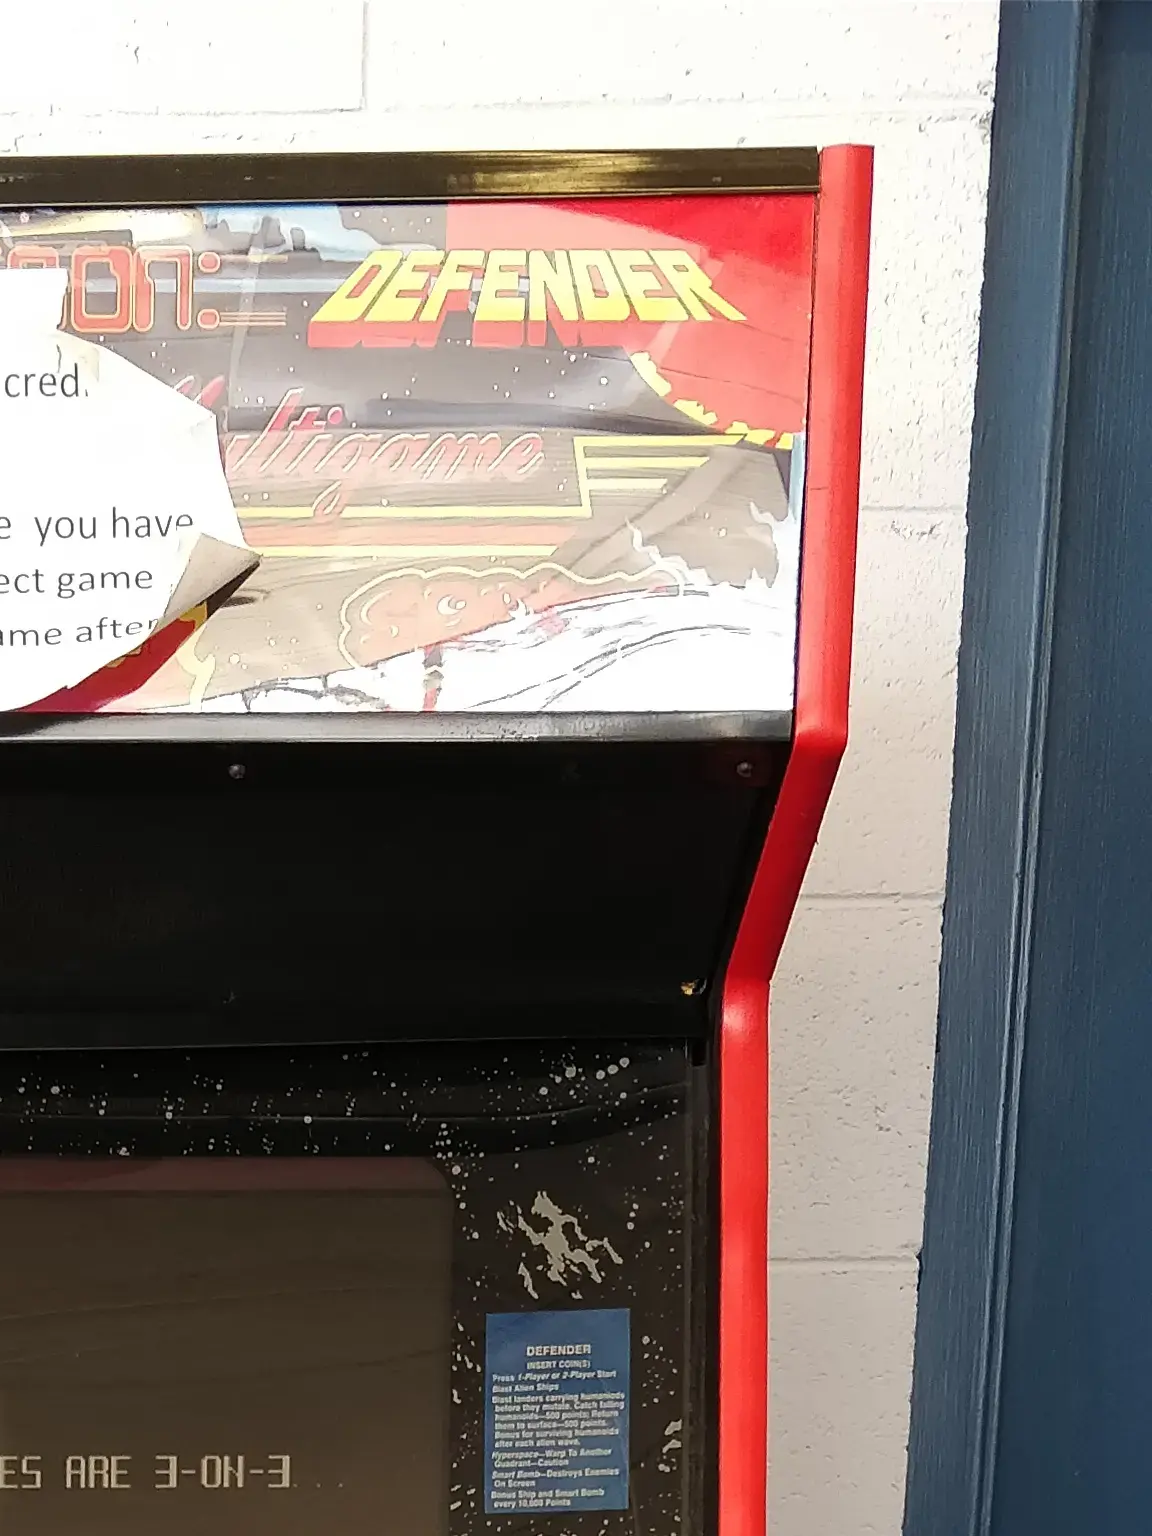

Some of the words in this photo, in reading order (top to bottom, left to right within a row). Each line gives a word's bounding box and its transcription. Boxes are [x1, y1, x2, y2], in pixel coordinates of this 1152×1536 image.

[309, 249, 746, 347] DEFENDER
[175, 376, 545, 519] ltigame
[34, 516, 97, 547] you
[112, 506, 194, 539] have
[57, 570, 153, 599] game
[76, 616, 159, 642] after
[526, 1344, 591, 1356] DEFENDER
[527, 1361, 557, 1370] INSERT
[558, 1360, 591, 1369] COIN(S)
[492, 1374, 515, 1382] Press
[518, 1373, 550, 1382] 1-Player
[562, 1371, 596, 1380] 2-Player
[597, 1370, 617, 1378] Start
[492, 1385, 512, 1393] Blast
[514, 1384, 535, 1392] Alien
[536, 1383, 559, 1392] Ships
[513, 1395, 544, 1403] landers
[545, 1394, 579, 1403] carrying
[495, 1404, 521, 1412] before
[522, 1404, 541, 1413] they
[574, 1401, 598, 1409] Catch
[521, 1430, 533, 1438] for
[495, 1440, 513, 1448] after
[536, 1439, 556, 1447] alien
[568, 1449, 577, 1457] To
[579, 1448, 612, 1456] Another
[66, 1455, 131, 1489] ARE
[492, 1471, 515, 1479] Smart
[584, 1468, 620, 1477] Enemies
[494, 1480, 506, 1488] On
[507, 1480, 536, 1488] Screen
[491, 1491, 516, 1499] Bonus
[518, 1490, 536, 1499] Ship
[538, 1490, 553, 1498] and
[555, 1489, 579, 1497] Smart
[580, 1488, 605, 1497] Bomb
[494, 1500, 516, 1509] every
[545, 1499, 571, 1507] Points
